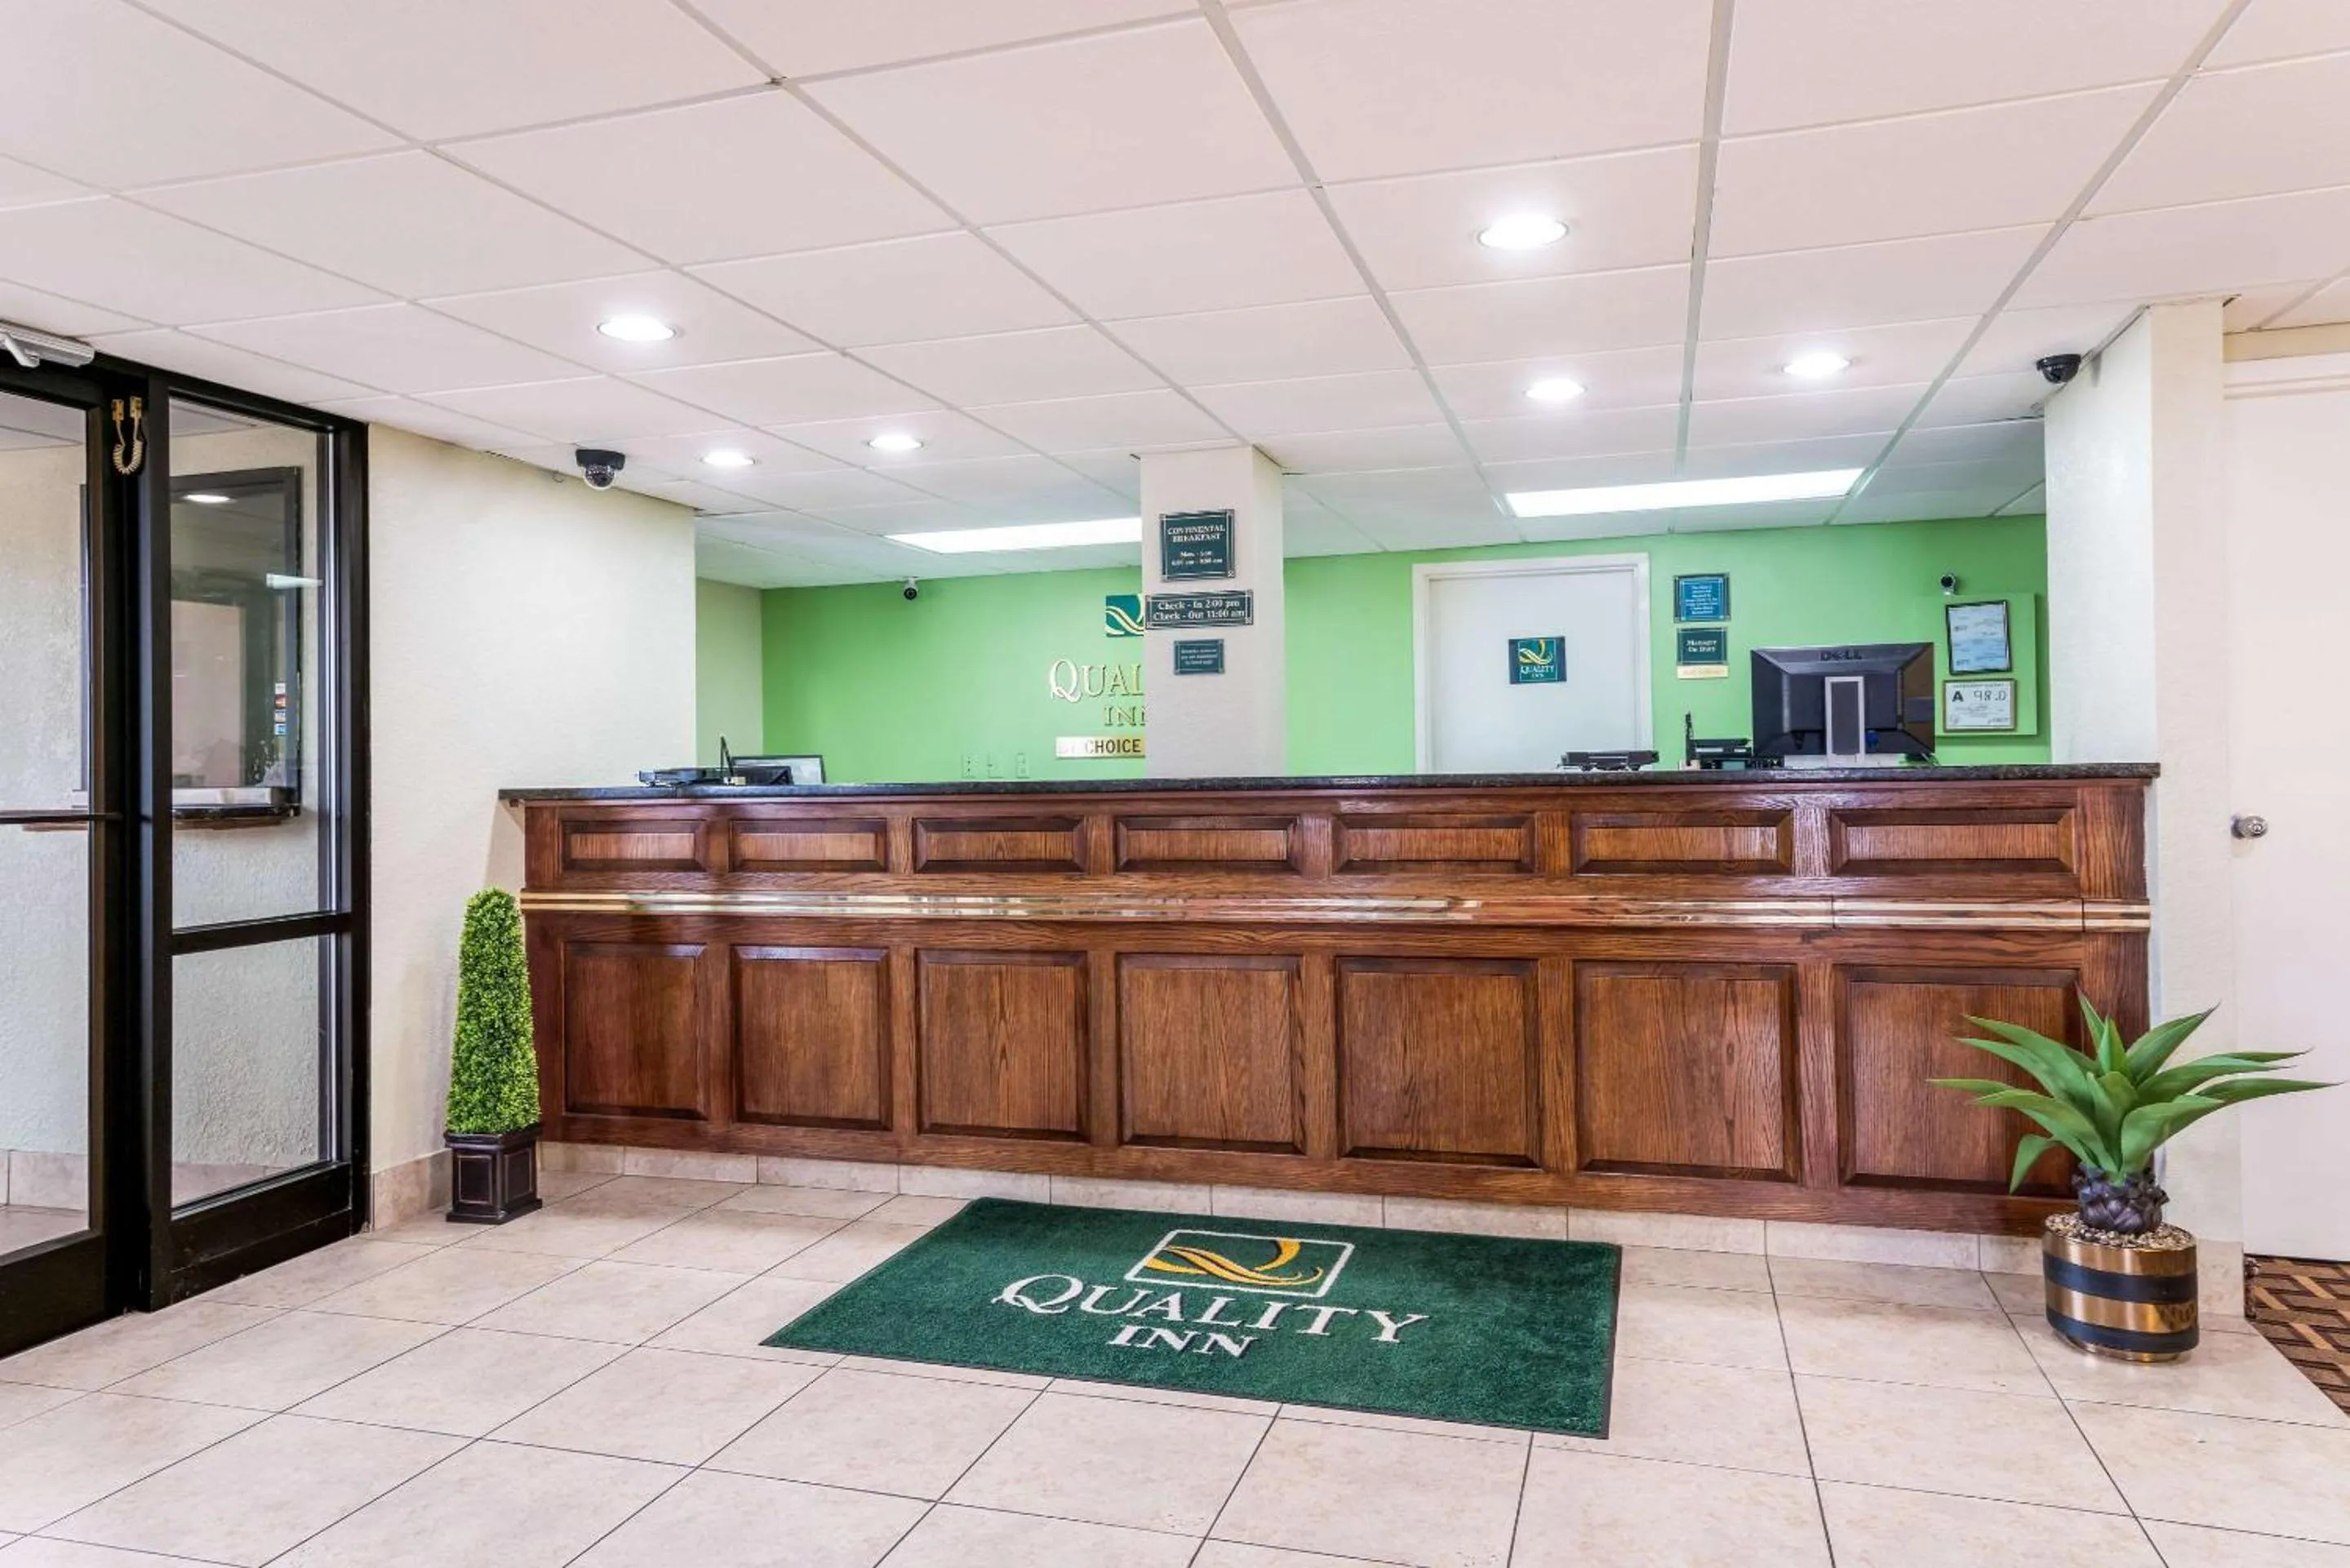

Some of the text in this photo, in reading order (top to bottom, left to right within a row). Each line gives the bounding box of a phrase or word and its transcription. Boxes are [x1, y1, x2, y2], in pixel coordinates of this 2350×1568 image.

[1167, 524, 1225, 535] CONTINENTAL
[1172, 533, 1220, 543] BREAKFAST
[1158, 601, 1185, 611] Check
[1193, 601, 1203, 609] In
[1153, 611, 1180, 620] Check
[1188, 611, 1205, 620] Out
[1521, 665, 1554, 674] QUALITY
[1952, 690, 1964, 702] A
[1085, 739, 1141, 754] CHOICE
[990, 1273, 1431, 1343] QUALITY
[1105, 1324, 1260, 1358] INN
